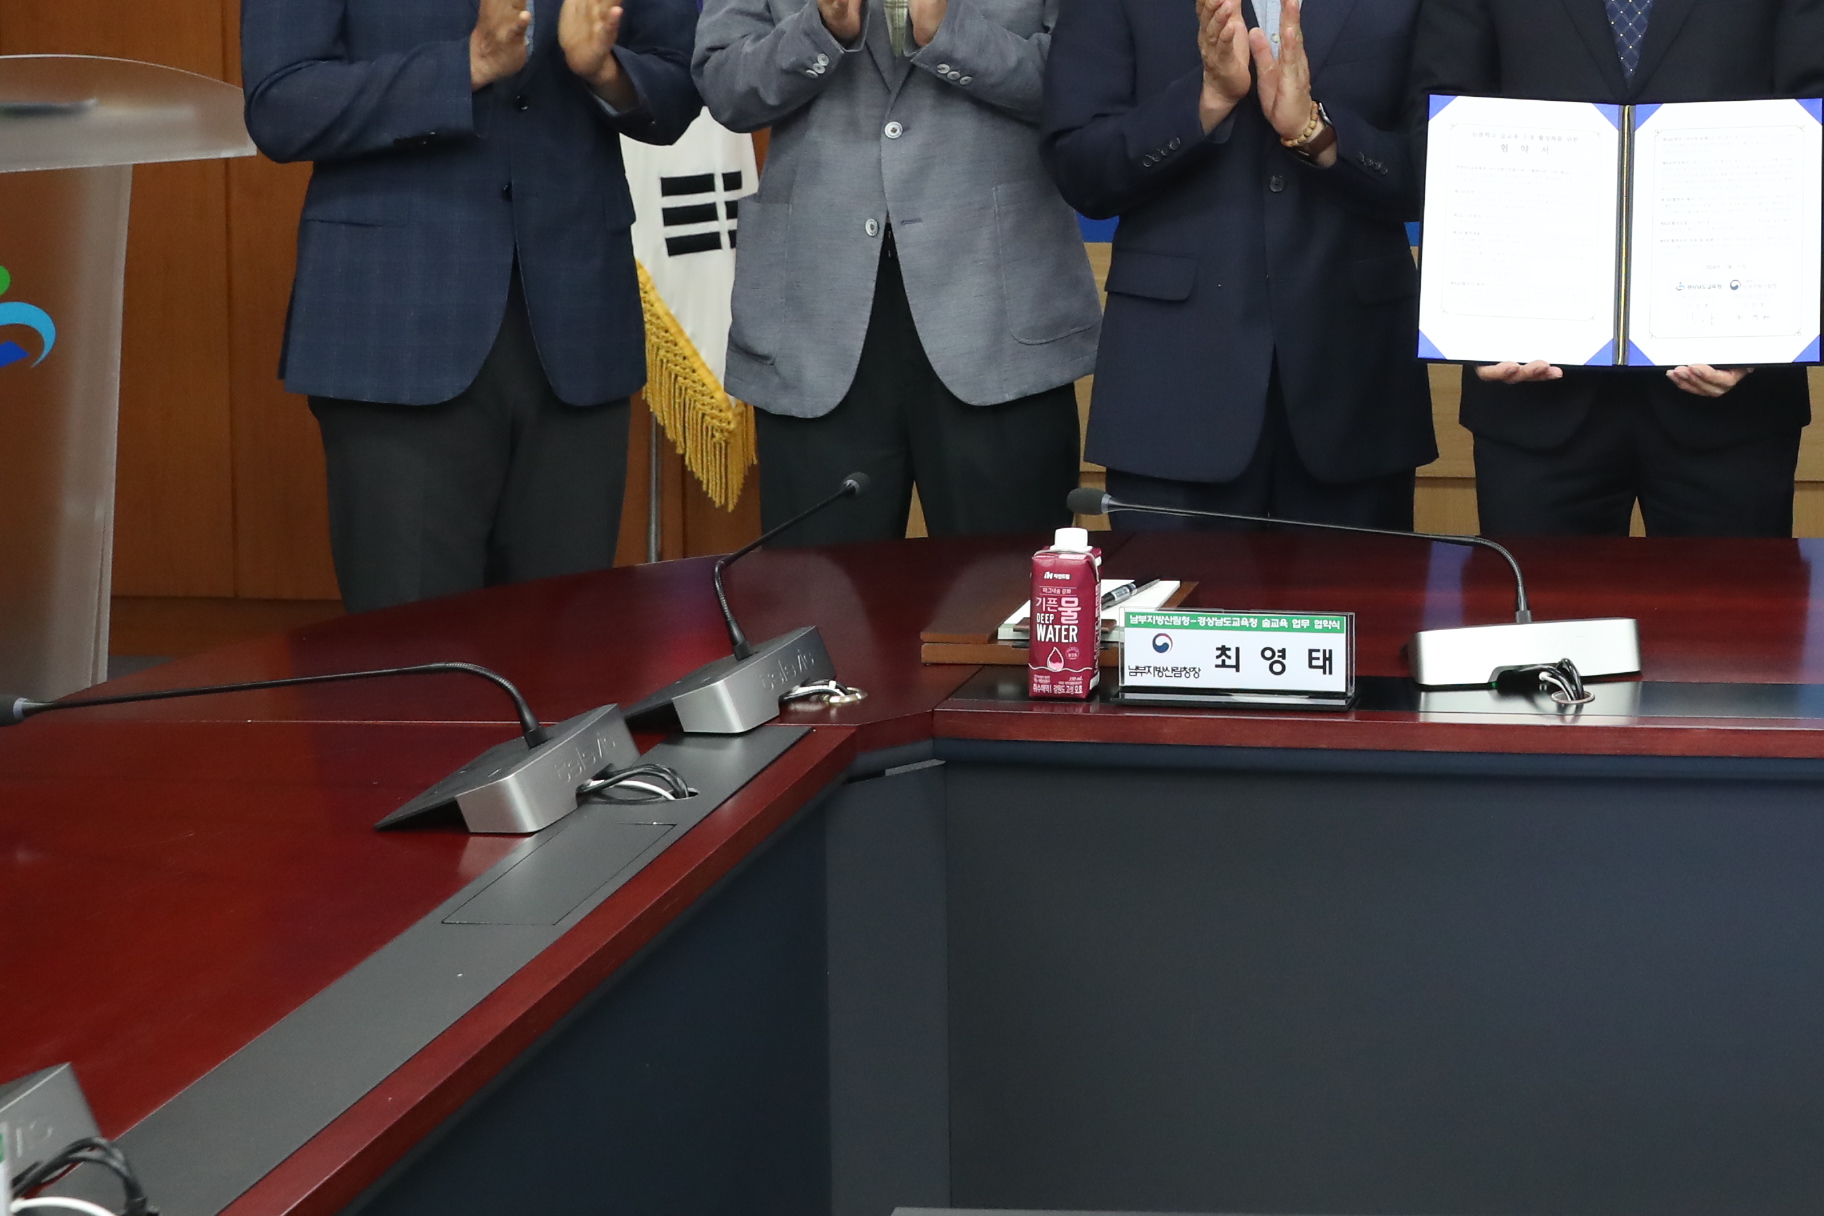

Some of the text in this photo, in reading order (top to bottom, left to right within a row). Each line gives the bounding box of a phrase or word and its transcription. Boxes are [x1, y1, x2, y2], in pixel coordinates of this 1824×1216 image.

[1036, 612, 1055, 624] DEEP
[1261, 618, 1289, 629] 숲교육
[1292, 619, 1310, 629] 업무
[1313, 619, 1341, 630] 협약식
[1036, 623, 1079, 643] WATER
[1128, 665, 1201, 679] 남부지방산림청장
